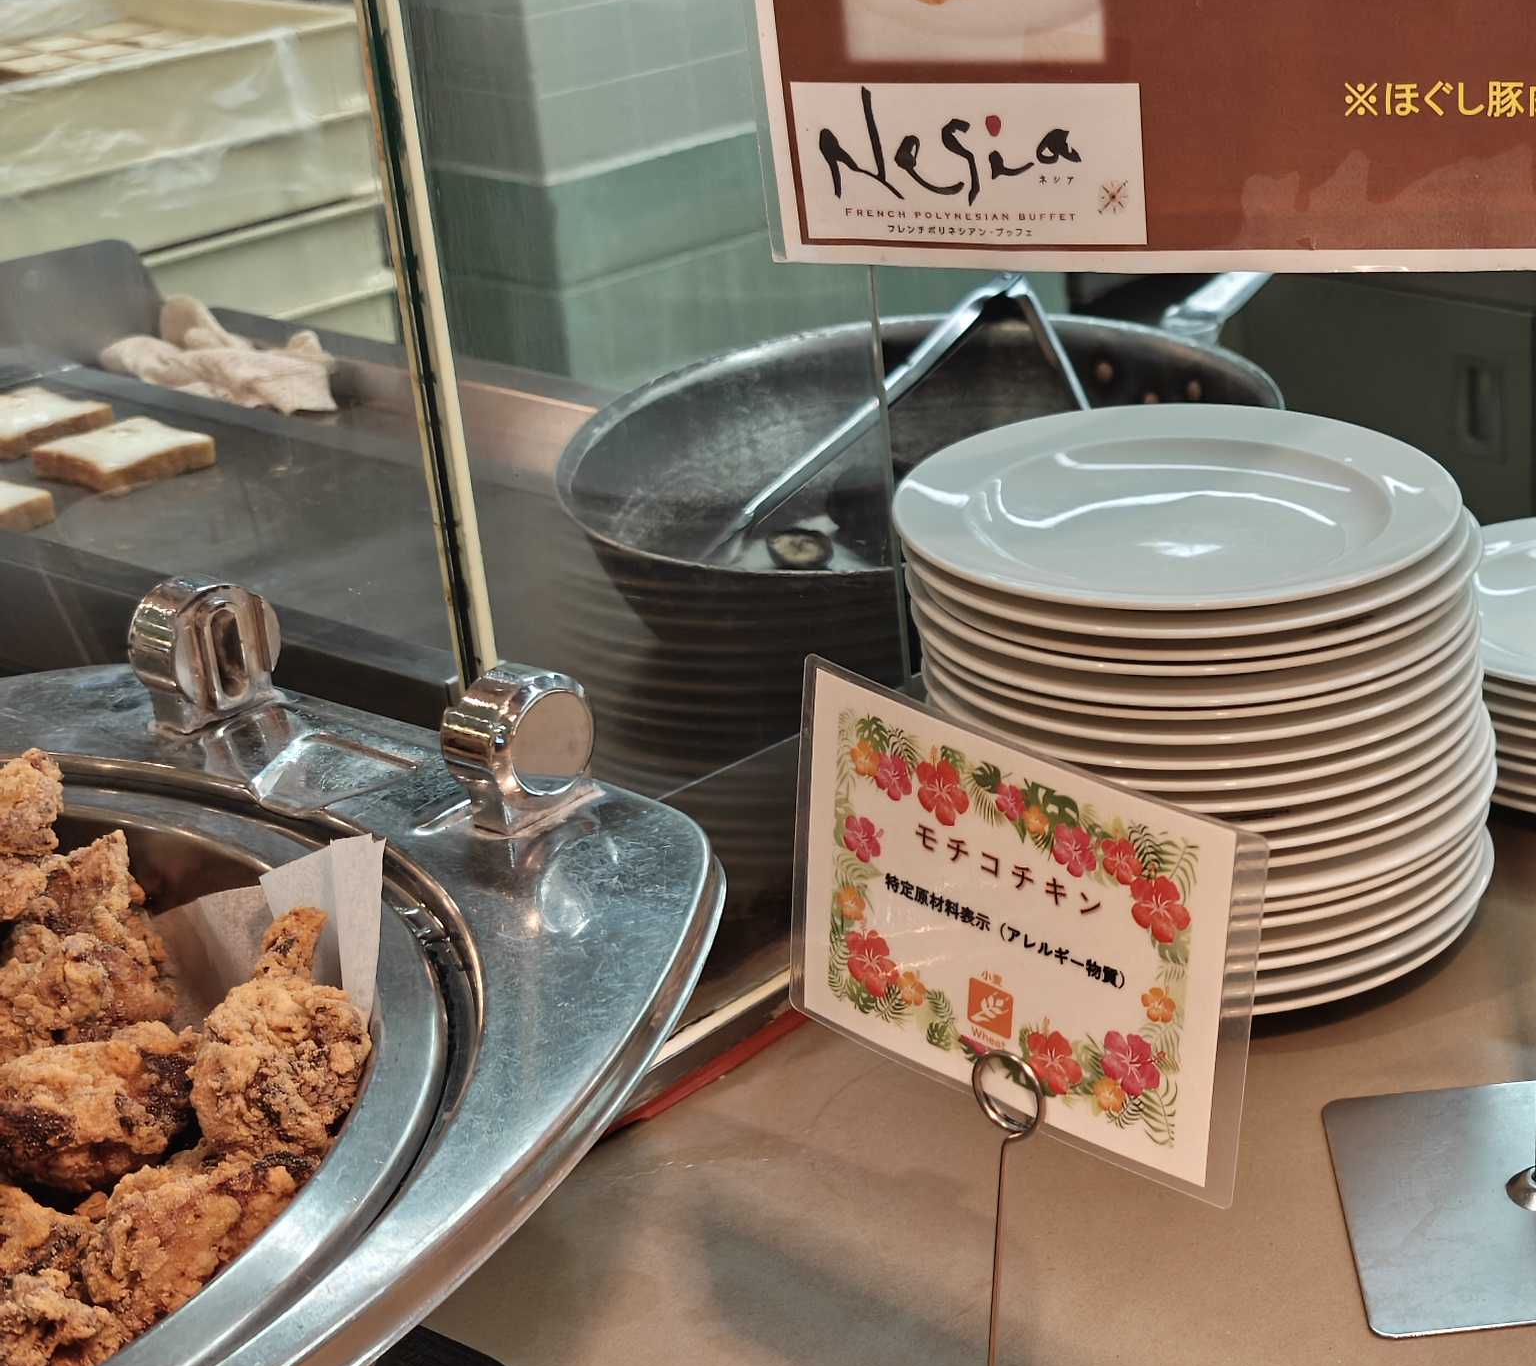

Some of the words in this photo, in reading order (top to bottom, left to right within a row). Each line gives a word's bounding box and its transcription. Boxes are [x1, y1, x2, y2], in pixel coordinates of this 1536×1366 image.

[914, 210, 1010, 222] POLYNESIAN
[1018, 212, 1078, 222] BUFFET
[915, 823, 1101, 915] モチコチキン
